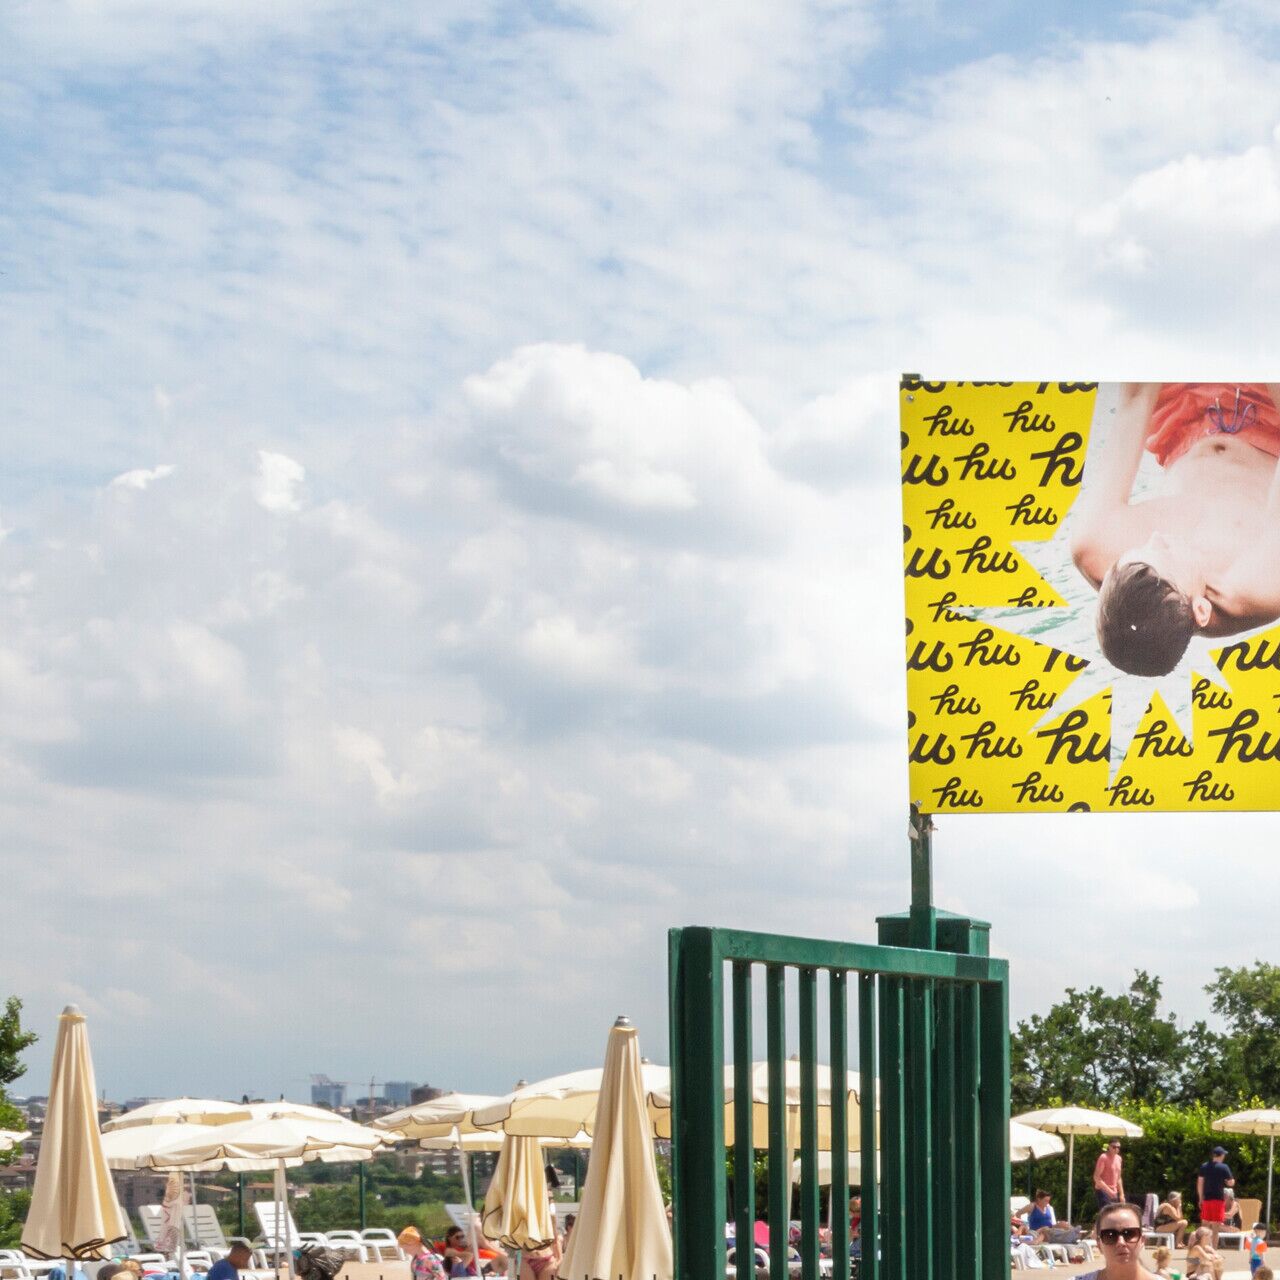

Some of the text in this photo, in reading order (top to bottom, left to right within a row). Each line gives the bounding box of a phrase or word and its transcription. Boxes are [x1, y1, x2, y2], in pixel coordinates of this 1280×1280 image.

[923, 401, 1056, 437] hu hu
[953, 443, 1017, 481] hu
[1030, 432, 1086, 487] h
[926, 493, 1058, 530] hu hu
[957, 536, 1019, 574] hu
[959, 628, 1021, 666] hu
[930, 679, 1057, 715] hu hu
[961, 720, 1023, 759] hu
[1134, 720, 1195, 758] hu
[932, 770, 1235, 808] hu hu hu hu
